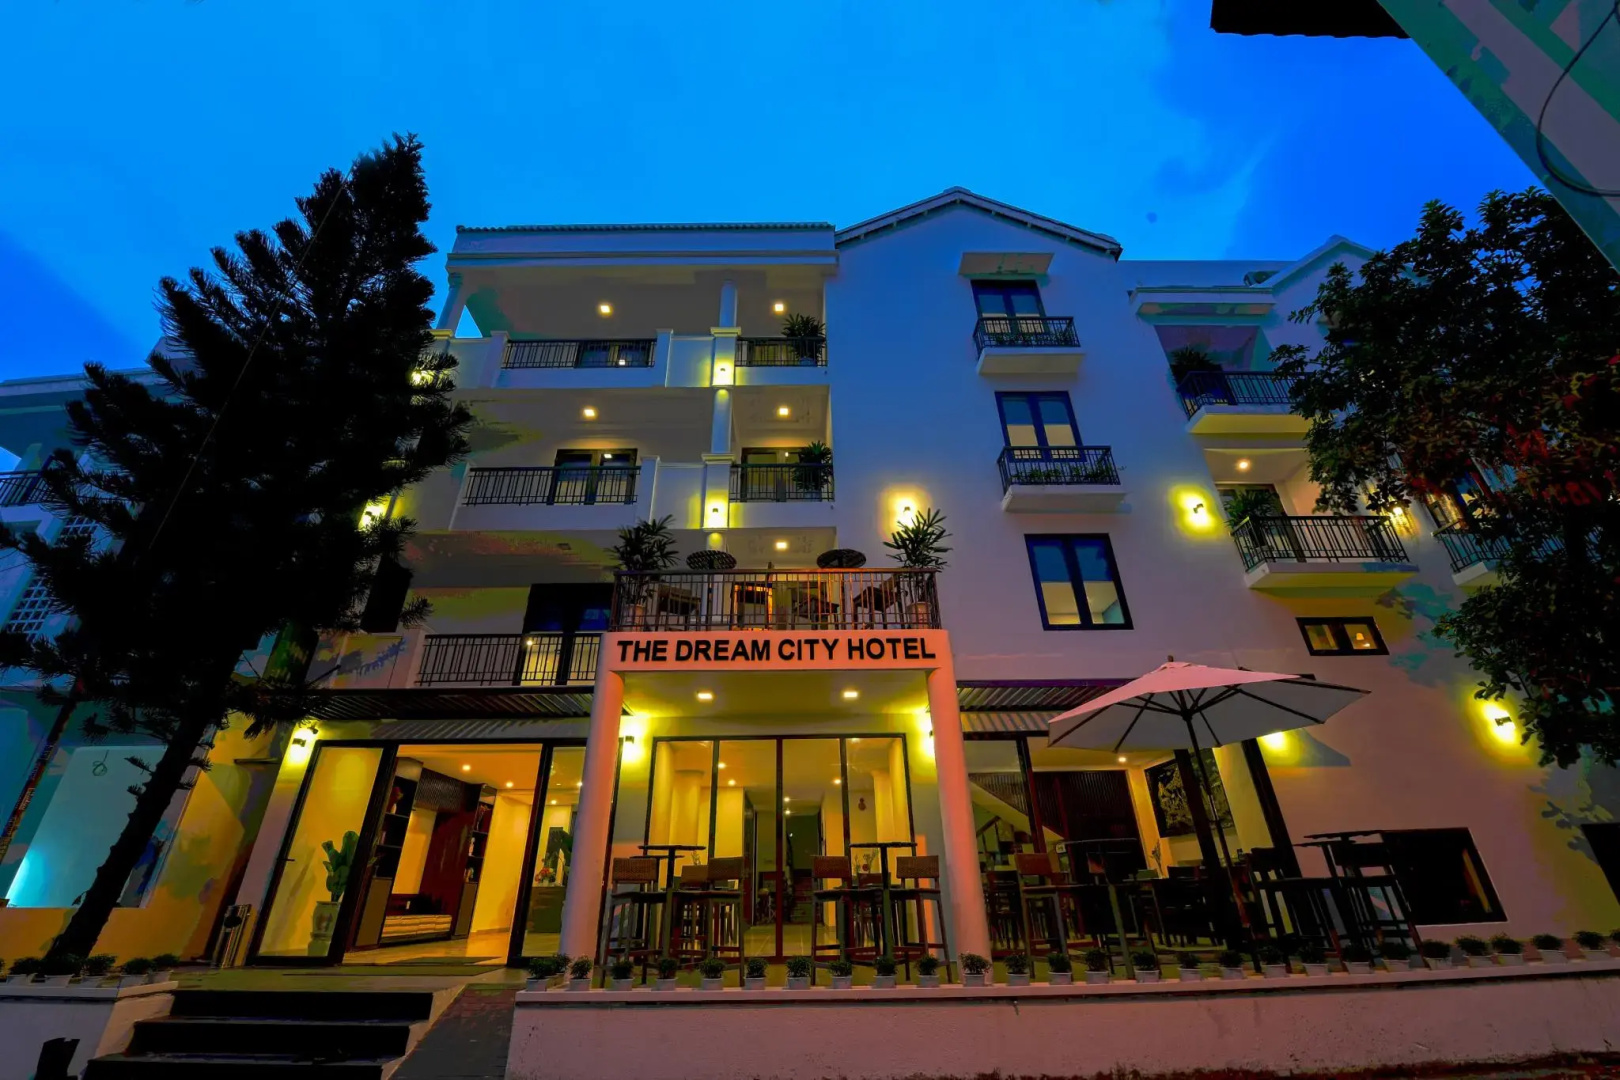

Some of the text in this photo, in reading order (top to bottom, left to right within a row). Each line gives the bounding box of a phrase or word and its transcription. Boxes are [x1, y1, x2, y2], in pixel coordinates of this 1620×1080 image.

[616, 637, 936, 662] THE DREAM CITY HOTEL
